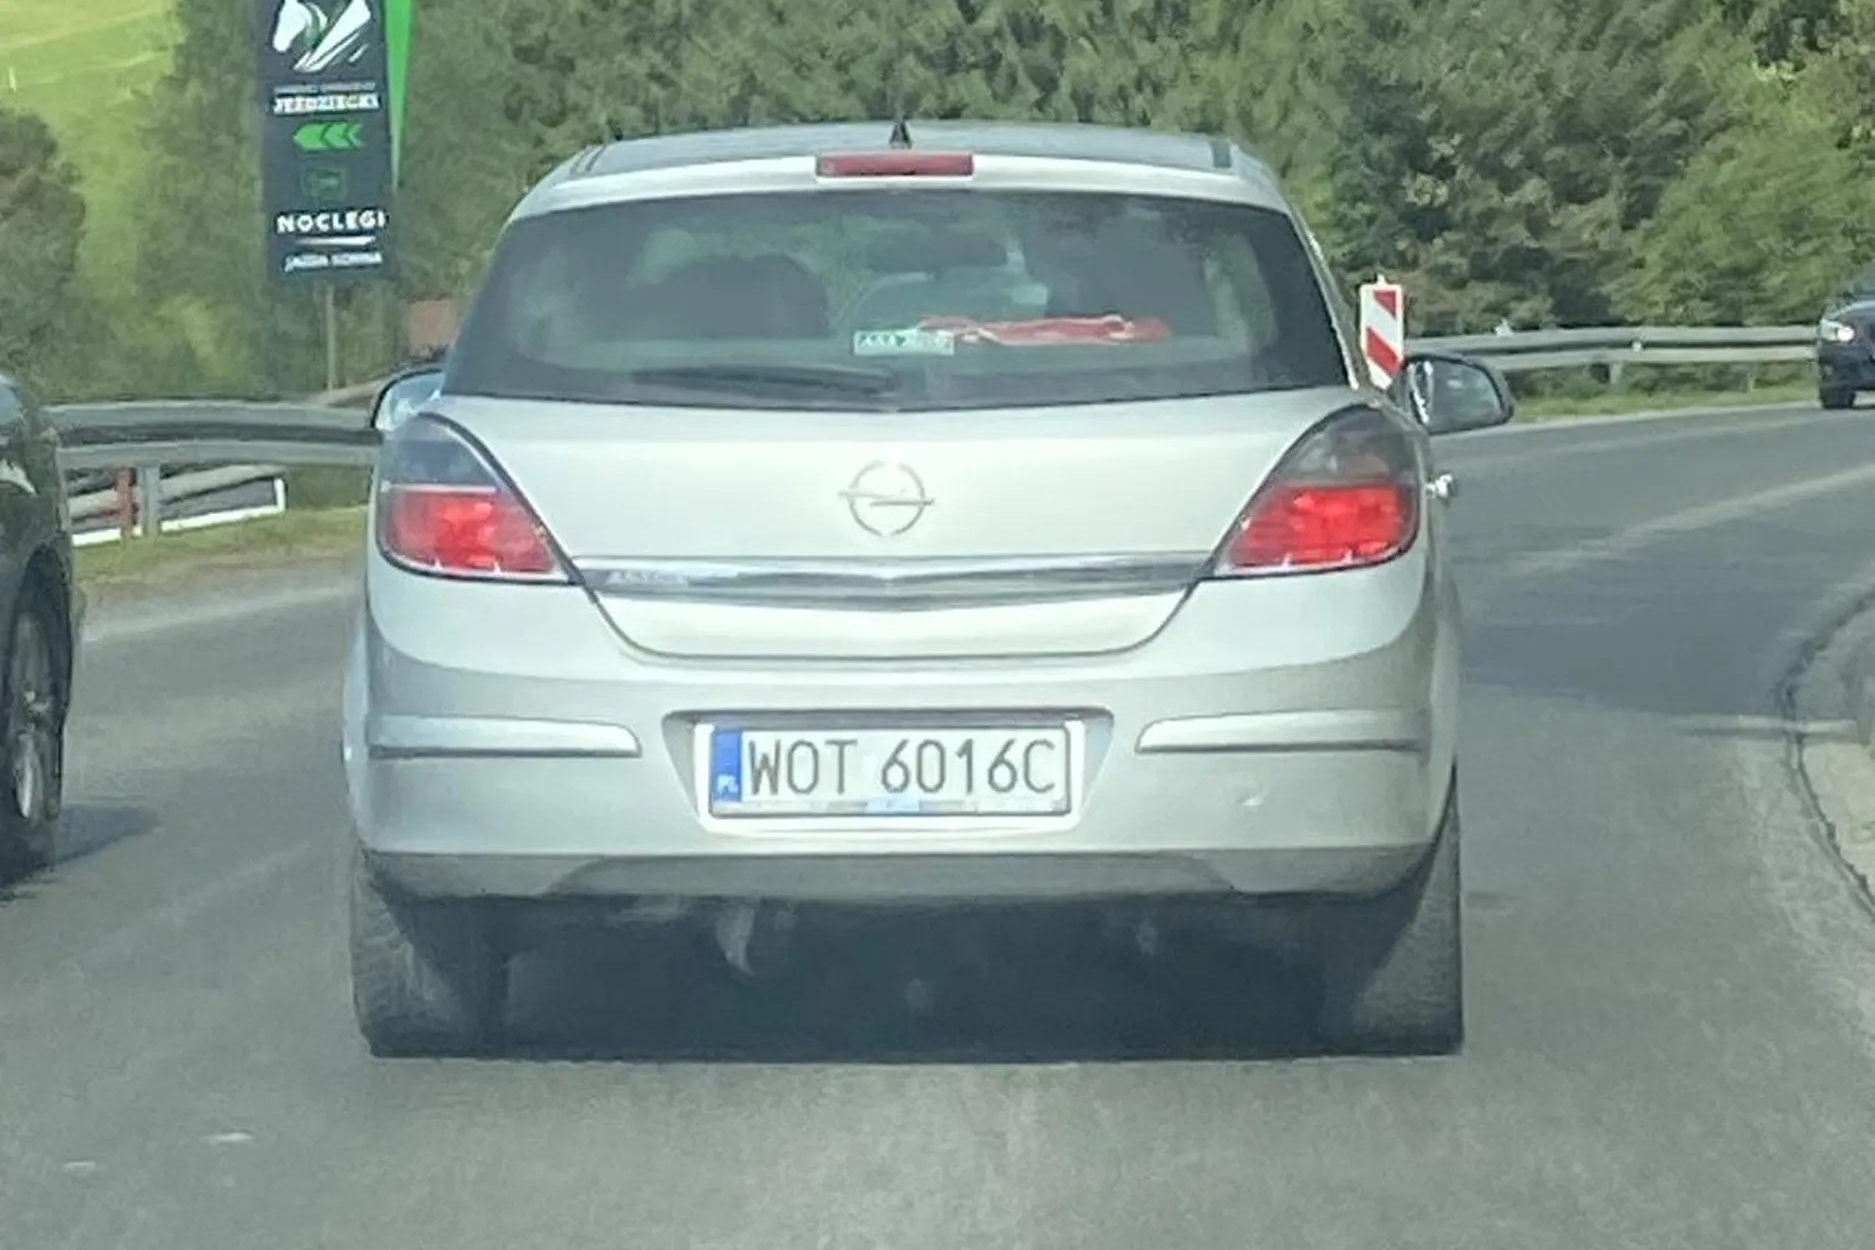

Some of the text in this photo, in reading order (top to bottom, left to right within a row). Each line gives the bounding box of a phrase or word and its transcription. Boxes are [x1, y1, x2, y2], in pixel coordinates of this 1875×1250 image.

[276, 210, 386, 233] NOCLEGI
[747, 738, 1056, 795] WOT 6016C
